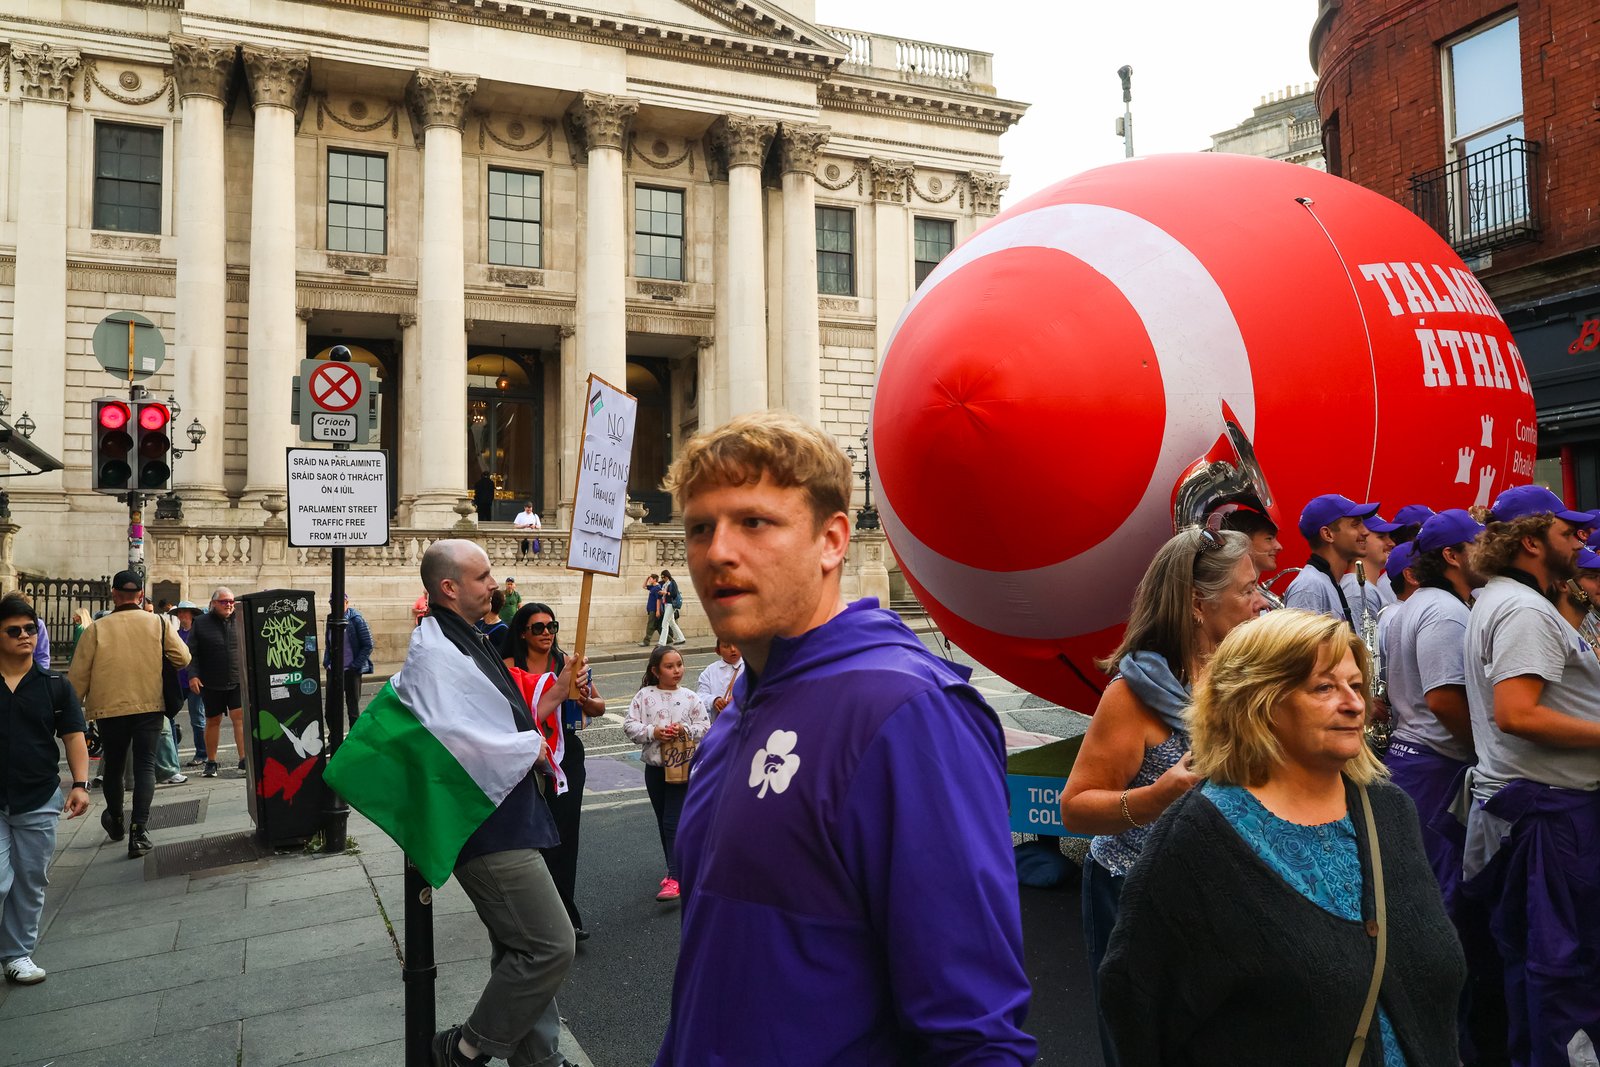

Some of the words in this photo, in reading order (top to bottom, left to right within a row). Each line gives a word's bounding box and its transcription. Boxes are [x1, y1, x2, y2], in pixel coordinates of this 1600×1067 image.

[1415, 318, 1512, 389] ÁTHA
[1507, 341, 1534, 400] C
[607, 413, 625, 438] NO
[323, 428, 347, 437] END
[293, 457, 317, 466] SRÁID
[318, 459, 330, 467] NA
[330, 459, 382, 468] PARLAIMINTE
[583, 448, 629, 483] WEAPONS
[291, 471, 315, 481] SRÁID
[316, 473, 338, 481] SAOR
[339, 472, 346, 481] Ó
[347, 471, 384, 482] THRÁCHT
[321, 484, 333, 494] ÓN
[333, 486, 339, 494] 4
[340, 485, 355, 495] IÚIL
[593, 482, 616, 506] THROUGH
[298, 505, 346, 514] PARLIAMENT
[348, 505, 378, 514] STREET
[311, 518, 344, 527] TRAFFIC
[345, 518, 366, 527] FREE
[309, 532, 332, 540] FROM
[332, 532, 347, 540] 4TH
[348, 532, 368, 540] JULY
[583, 542, 615, 571] AIRPORT!
[1029, 808, 1064, 826] COL
